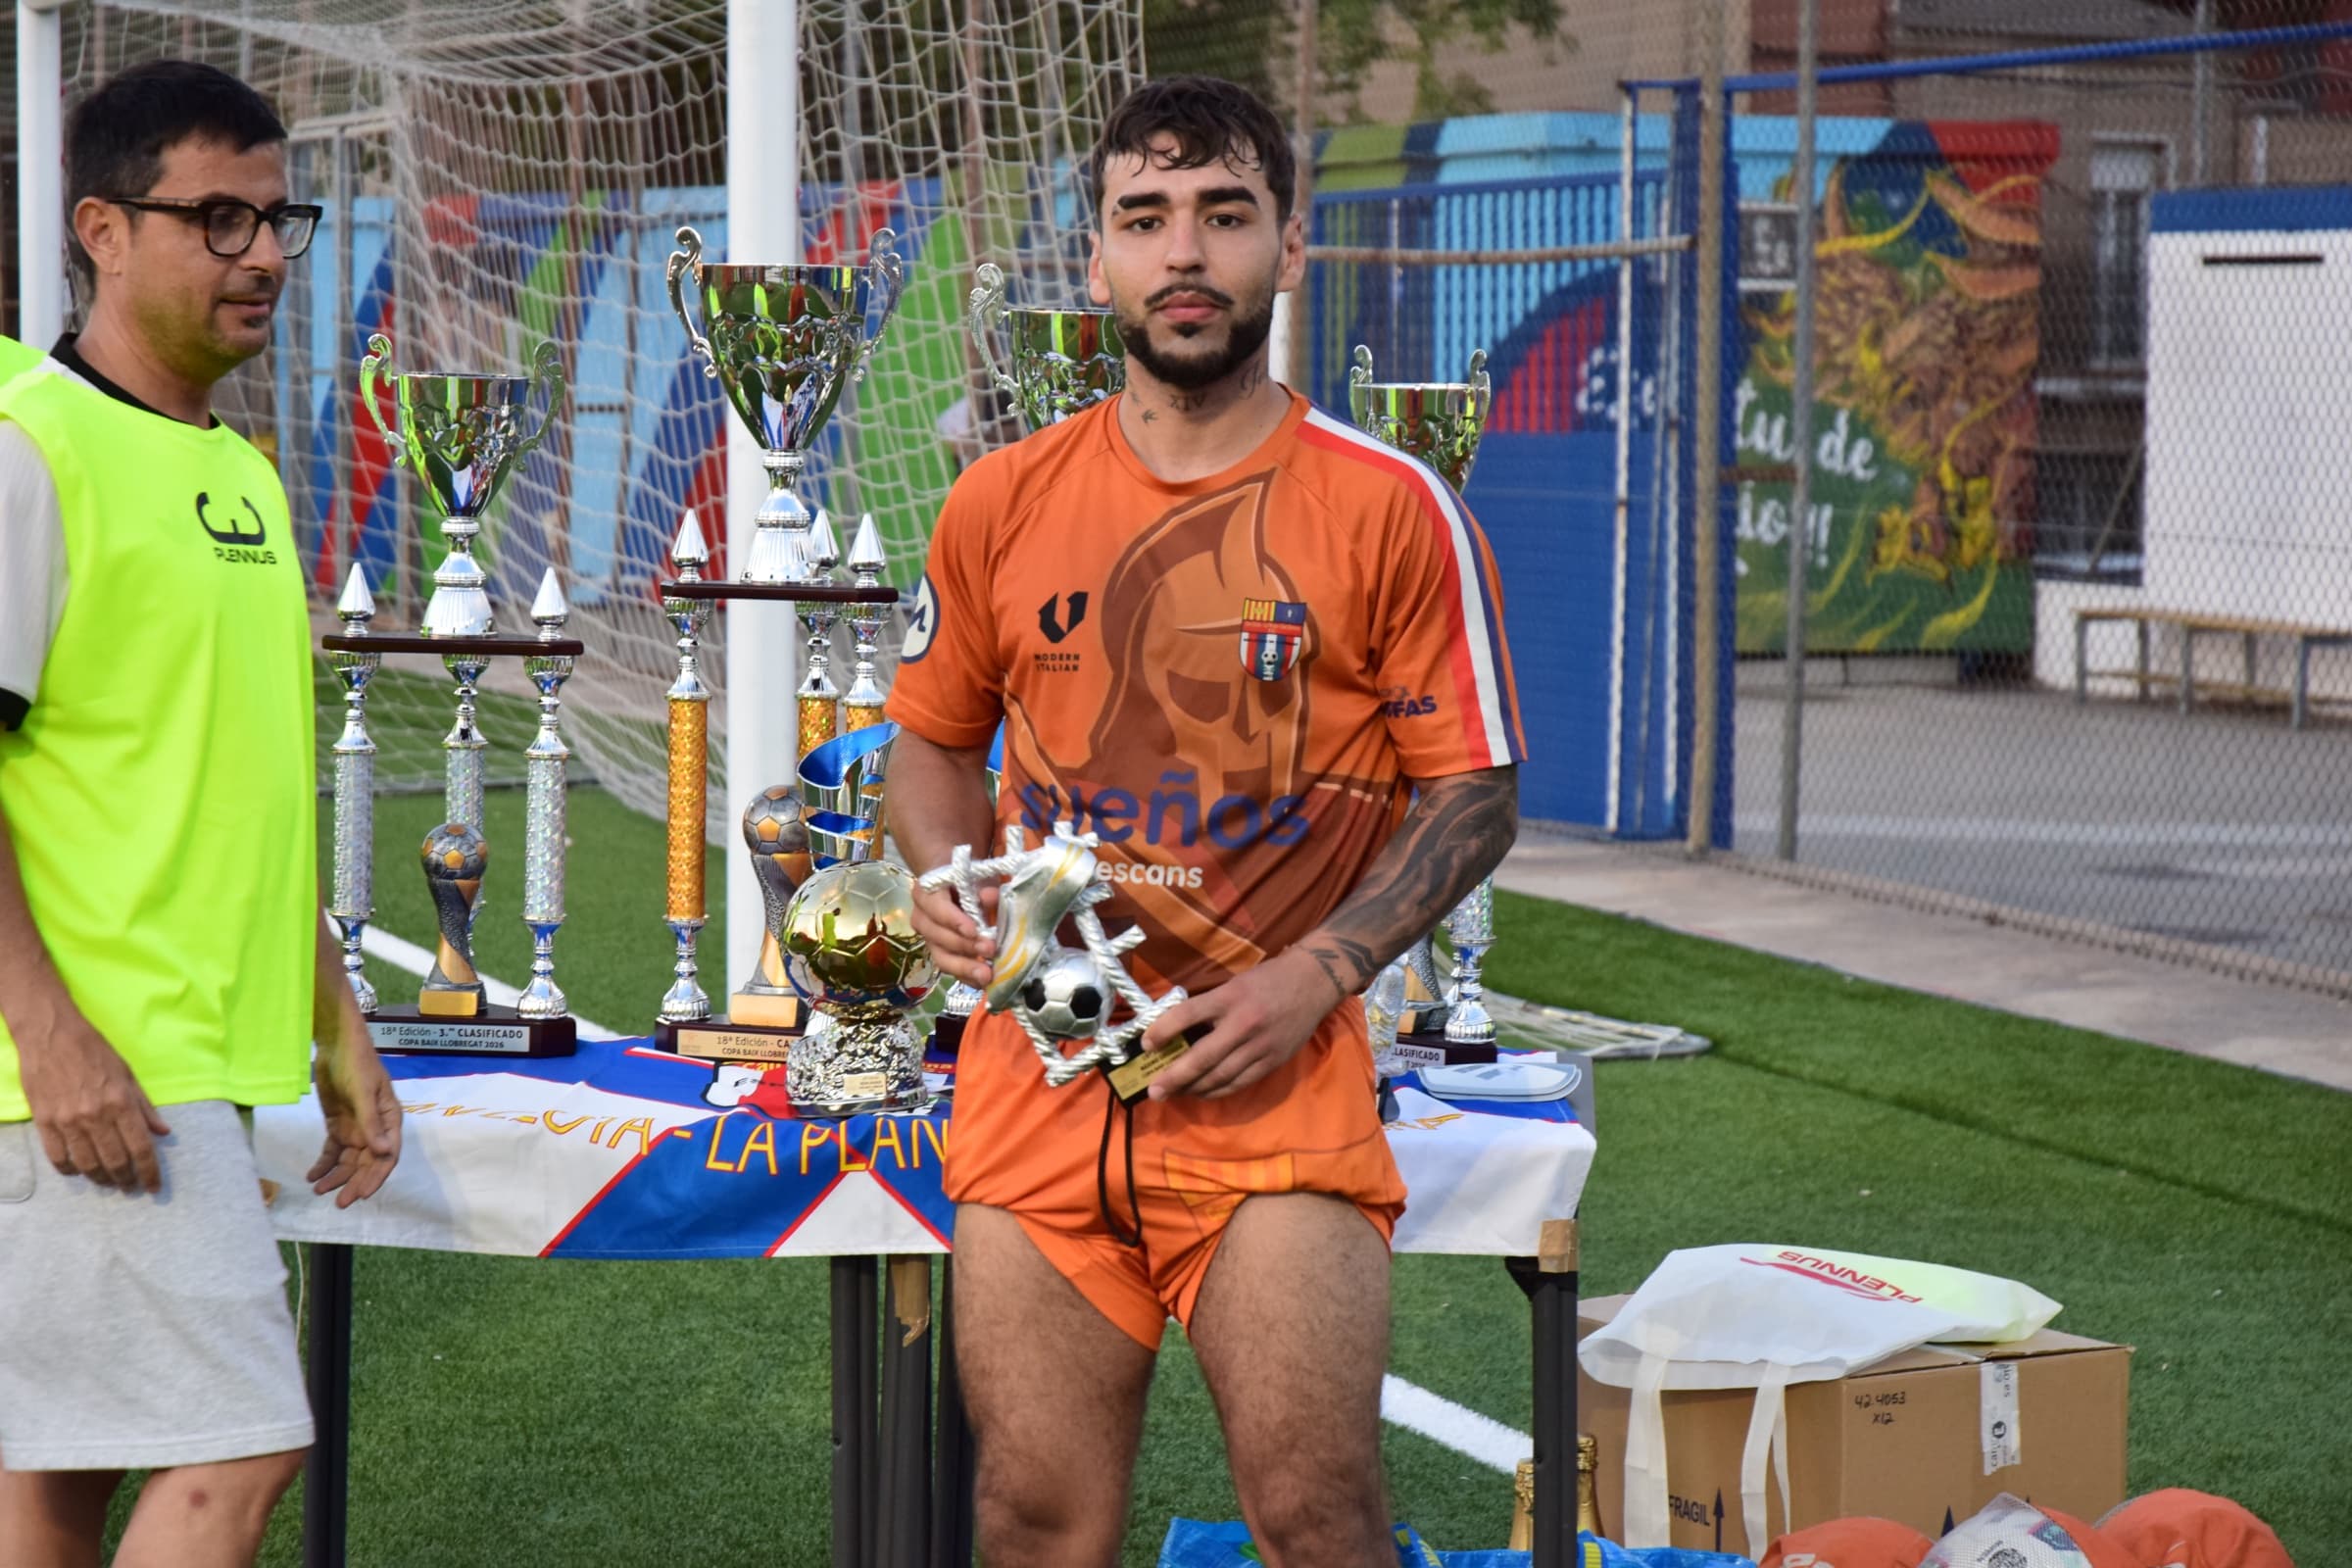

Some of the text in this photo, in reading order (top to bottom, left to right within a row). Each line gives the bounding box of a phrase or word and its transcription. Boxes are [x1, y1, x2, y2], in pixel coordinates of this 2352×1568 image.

[1817, 408, 1879, 480] de
[1034, 653, 1081, 662] MODERN
[1094, 858, 1203, 889] escans
[398, 1026, 432, 1037] Edición
[457, 1028, 524, 1040] CLASIFICADO
[398, 1038, 419, 1047] COPA
[735, 1036, 769, 1048] Edición
[721, 1048, 742, 1056] COPA
[1393, 1048, 1440, 1061] LASIFICADO
[705, 1114, 779, 1176] LA
[799, 1115, 950, 1176] PLAN
[1777, 1250, 1924, 1304] PLENNUS
